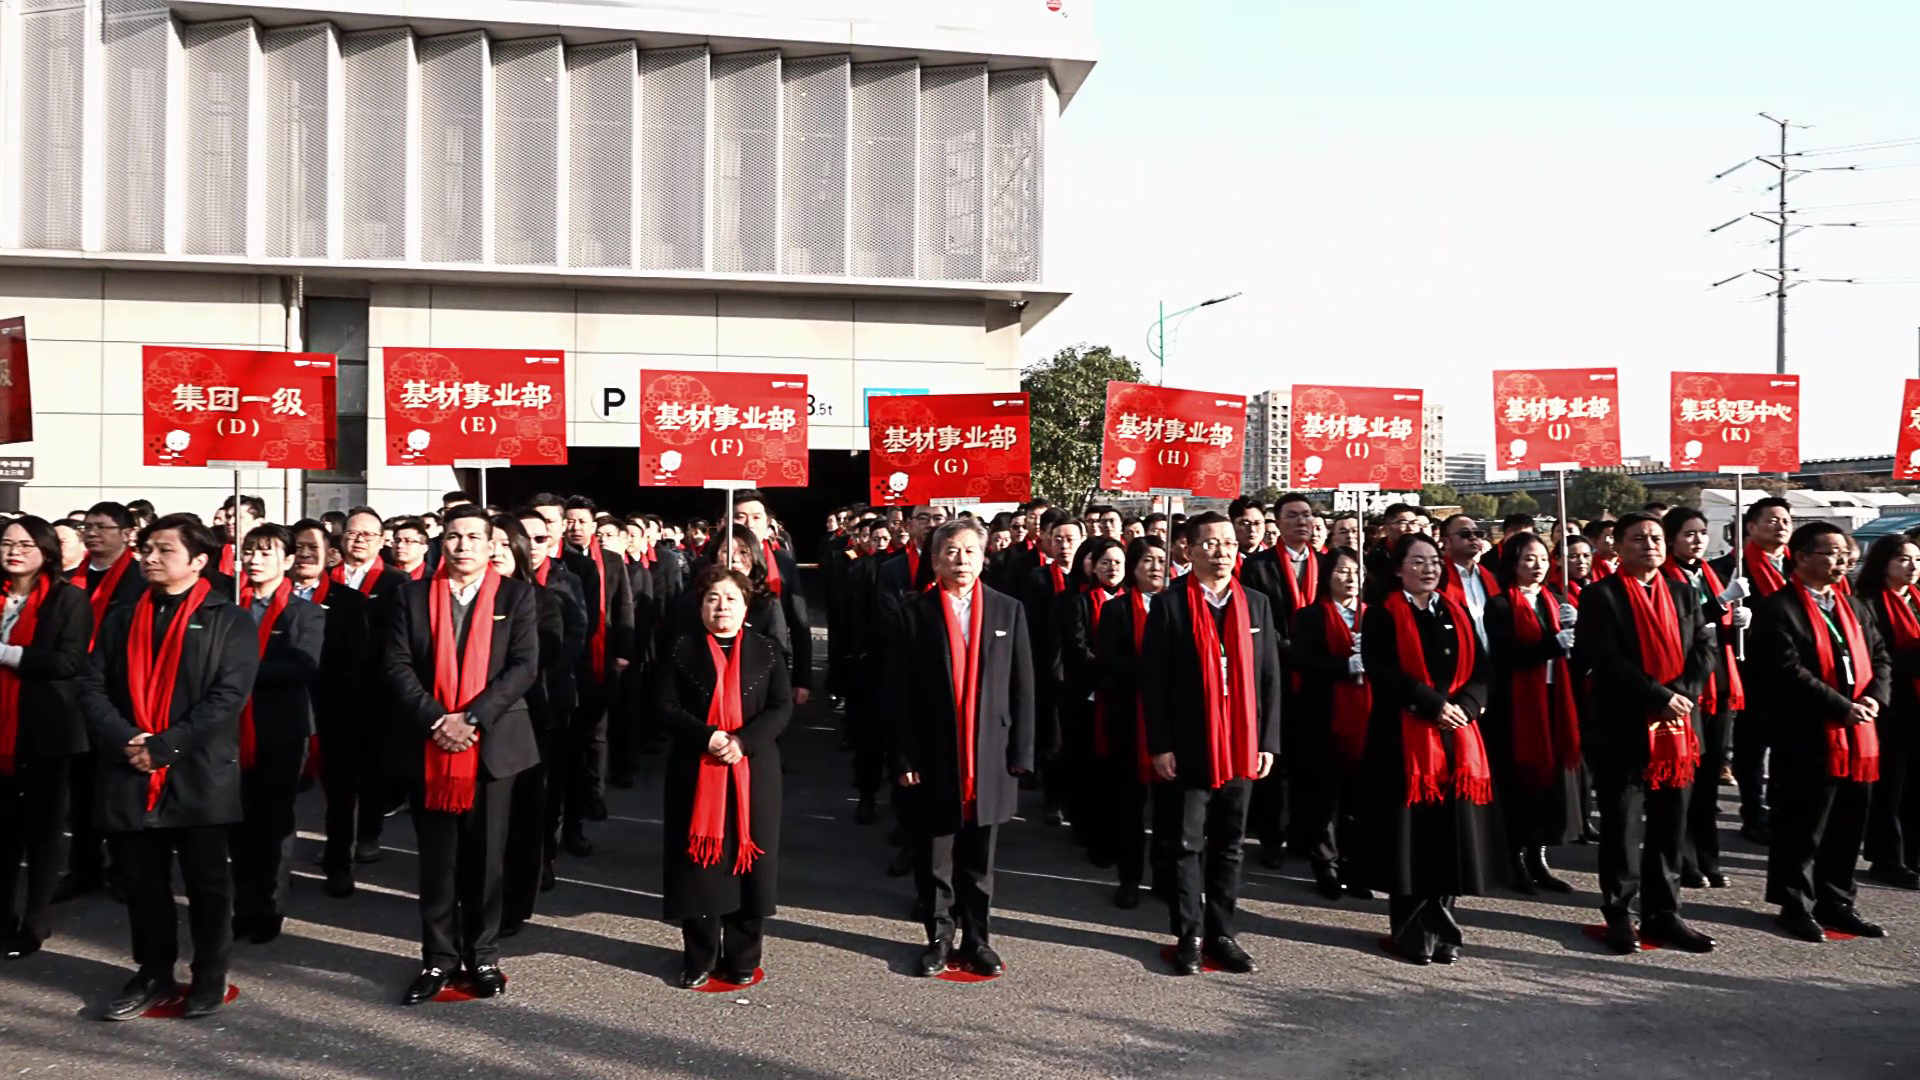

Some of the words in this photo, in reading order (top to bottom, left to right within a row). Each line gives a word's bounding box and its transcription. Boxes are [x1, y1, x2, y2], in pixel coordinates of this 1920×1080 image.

[173, 383, 307, 418] 集团一级
[400, 380, 552, 412] 基材事业部
[604, 388, 625, 416] P
[1505, 396, 1611, 423] 基材事业部
[460, 415, 497, 435] (E)
[654, 402, 797, 434] 基材事业部
[1680, 398, 1793, 425] 集采贸易中心
[216, 417, 260, 437] (D)
[882, 424, 1017, 453] 基材事业部
[1116, 412, 1234, 449] 基材事业部
[1302, 412, 1413, 441] 基材事业部
[1547, 424, 1571, 441] (J)
[1721, 427, 1751, 443] (K)
[710, 438, 744, 457] (F)
[1158, 450, 1190, 467] (H)
[934, 458, 968, 476] (G)
